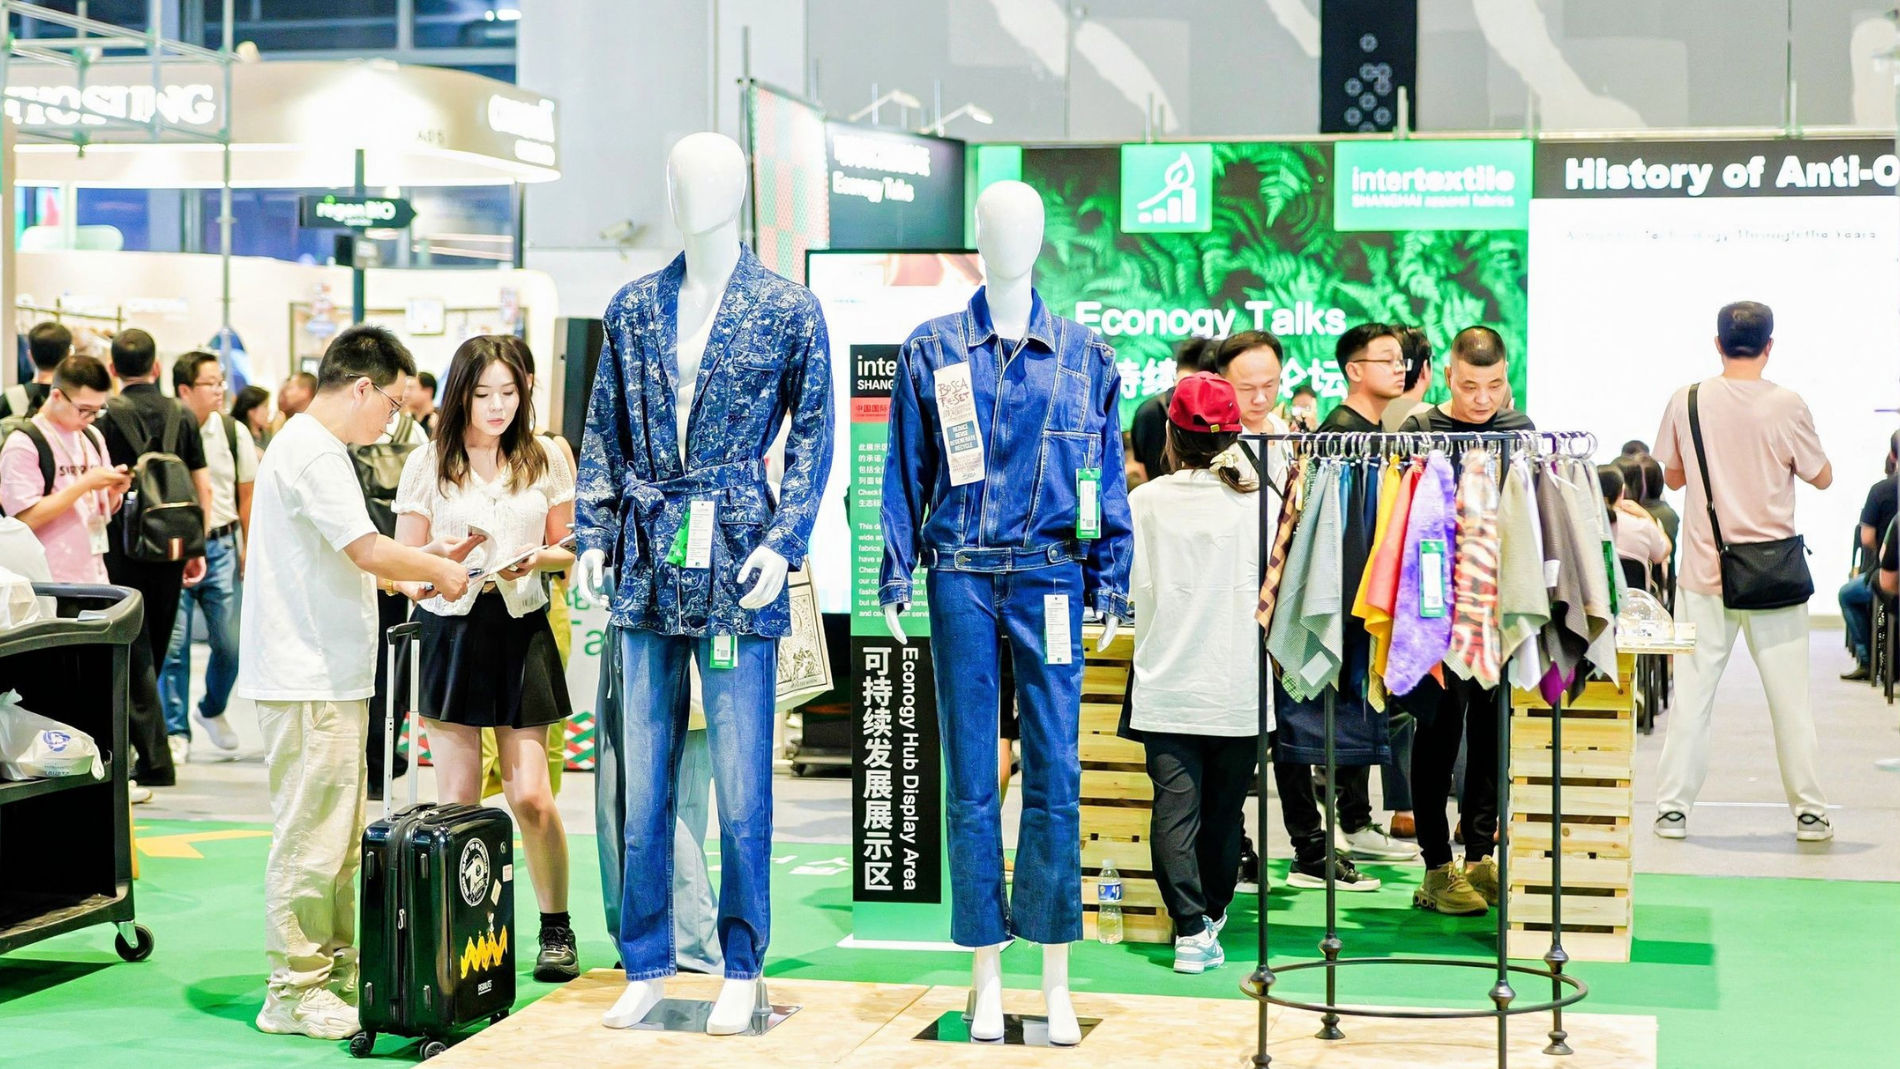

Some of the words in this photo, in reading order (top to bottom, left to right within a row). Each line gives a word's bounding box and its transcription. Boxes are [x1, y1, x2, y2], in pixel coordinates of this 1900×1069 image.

[1352, 165, 1516, 192] intertextile
[1565, 158, 1713, 196] History
[1722, 156, 1766, 188] of
[1075, 301, 1236, 341] Econogy
[1245, 301, 1347, 336] Talks
[899, 647, 918, 729] Econogy
[862, 646, 893, 891] 可持续发展展示区
[903, 733, 919, 770] Hub
[899, 775, 919, 844] Display
[903, 848, 919, 891] Area
